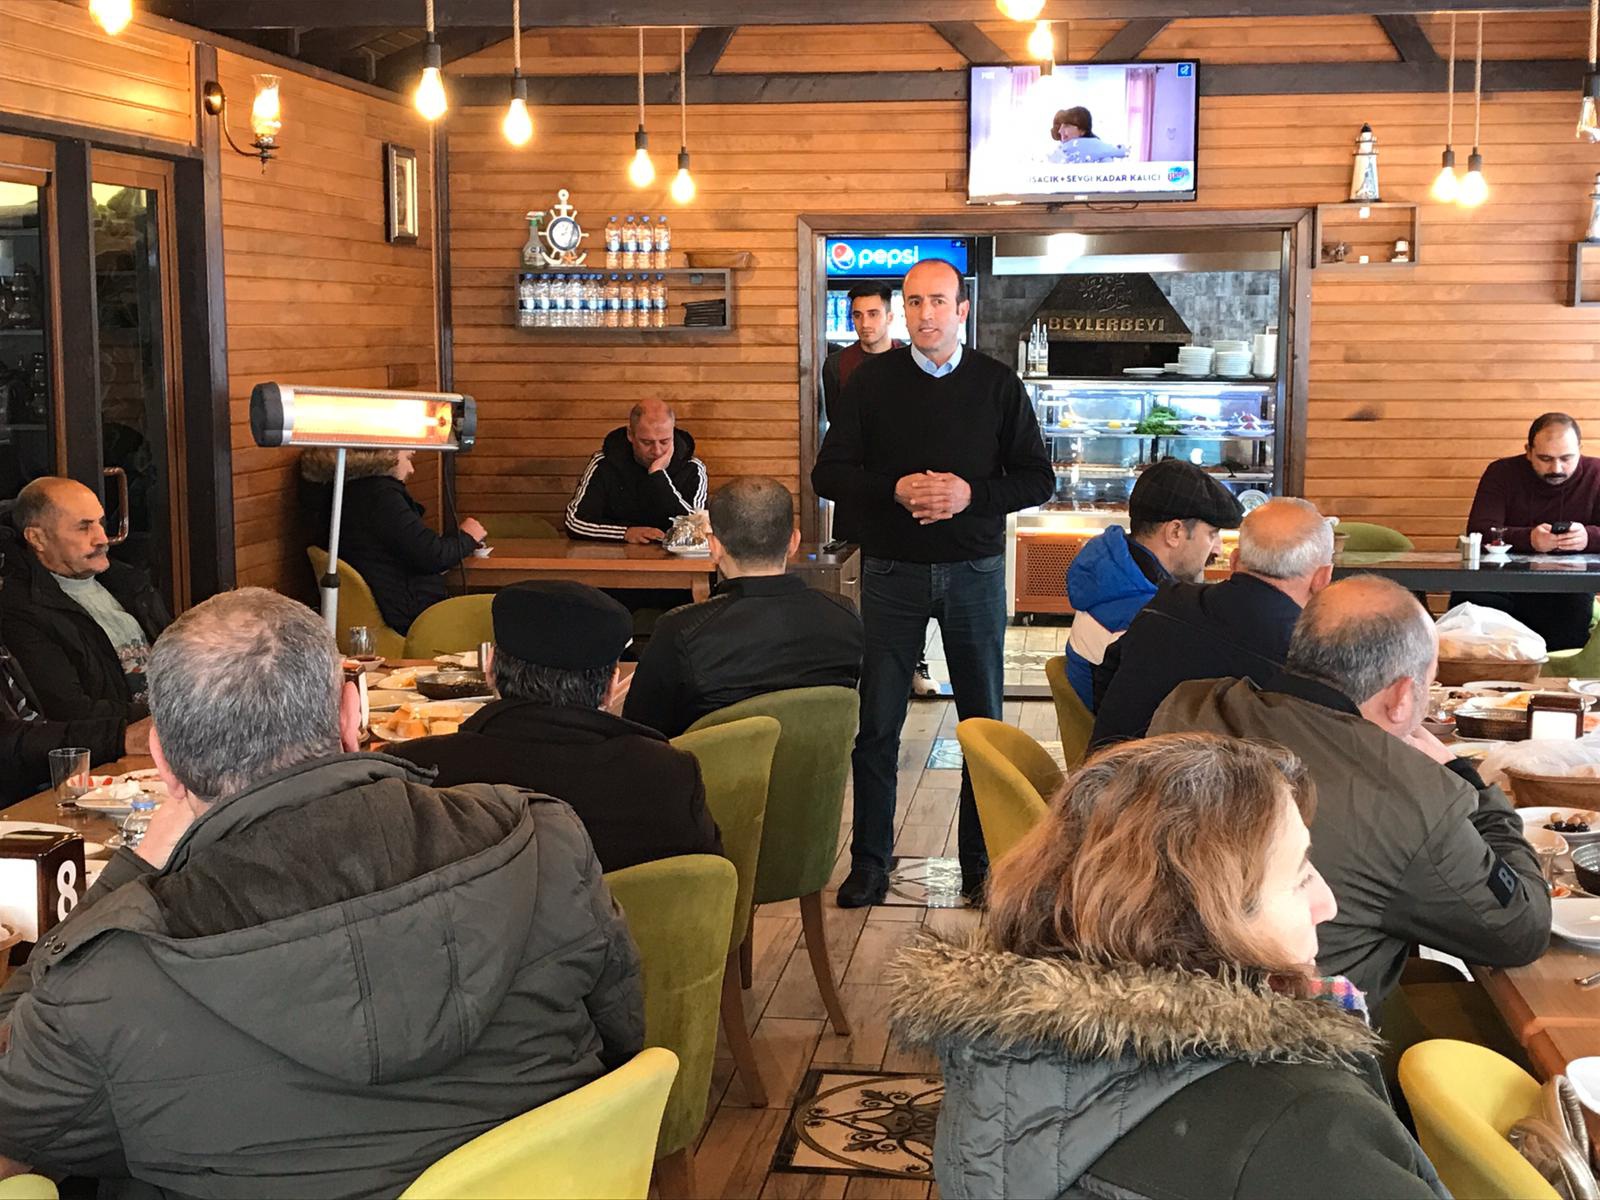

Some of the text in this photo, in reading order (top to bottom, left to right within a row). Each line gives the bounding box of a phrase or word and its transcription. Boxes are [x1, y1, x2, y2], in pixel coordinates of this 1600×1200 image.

[1095, 174, 1127, 182] KADAR
[858, 245, 919, 268] pepsi
[57, 859, 78, 922] 8
